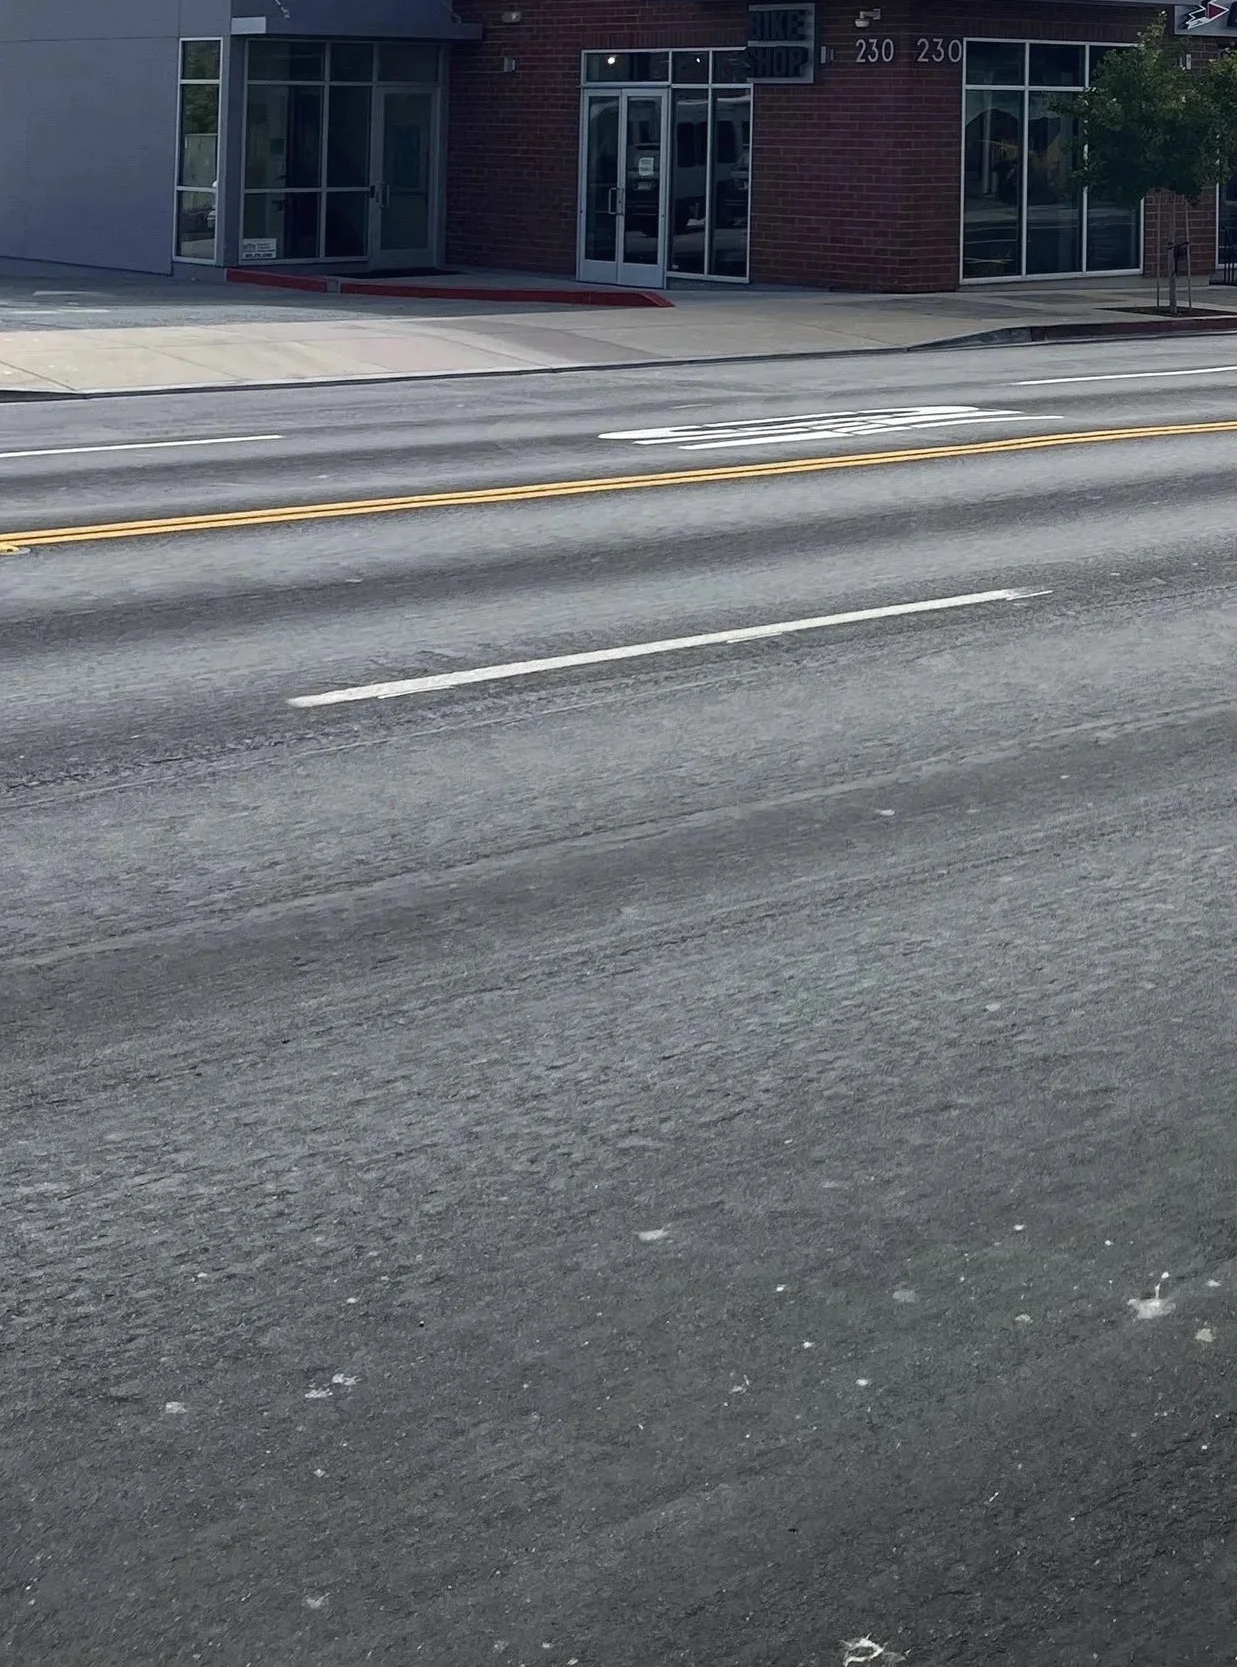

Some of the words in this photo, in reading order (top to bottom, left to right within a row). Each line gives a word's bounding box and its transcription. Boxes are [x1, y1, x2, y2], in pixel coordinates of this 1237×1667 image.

[749, 9, 806, 40] BIKE
[747, 46, 809, 77] SHOP
[855, 38, 895, 63] 230
[916, 37, 963, 63] 230
